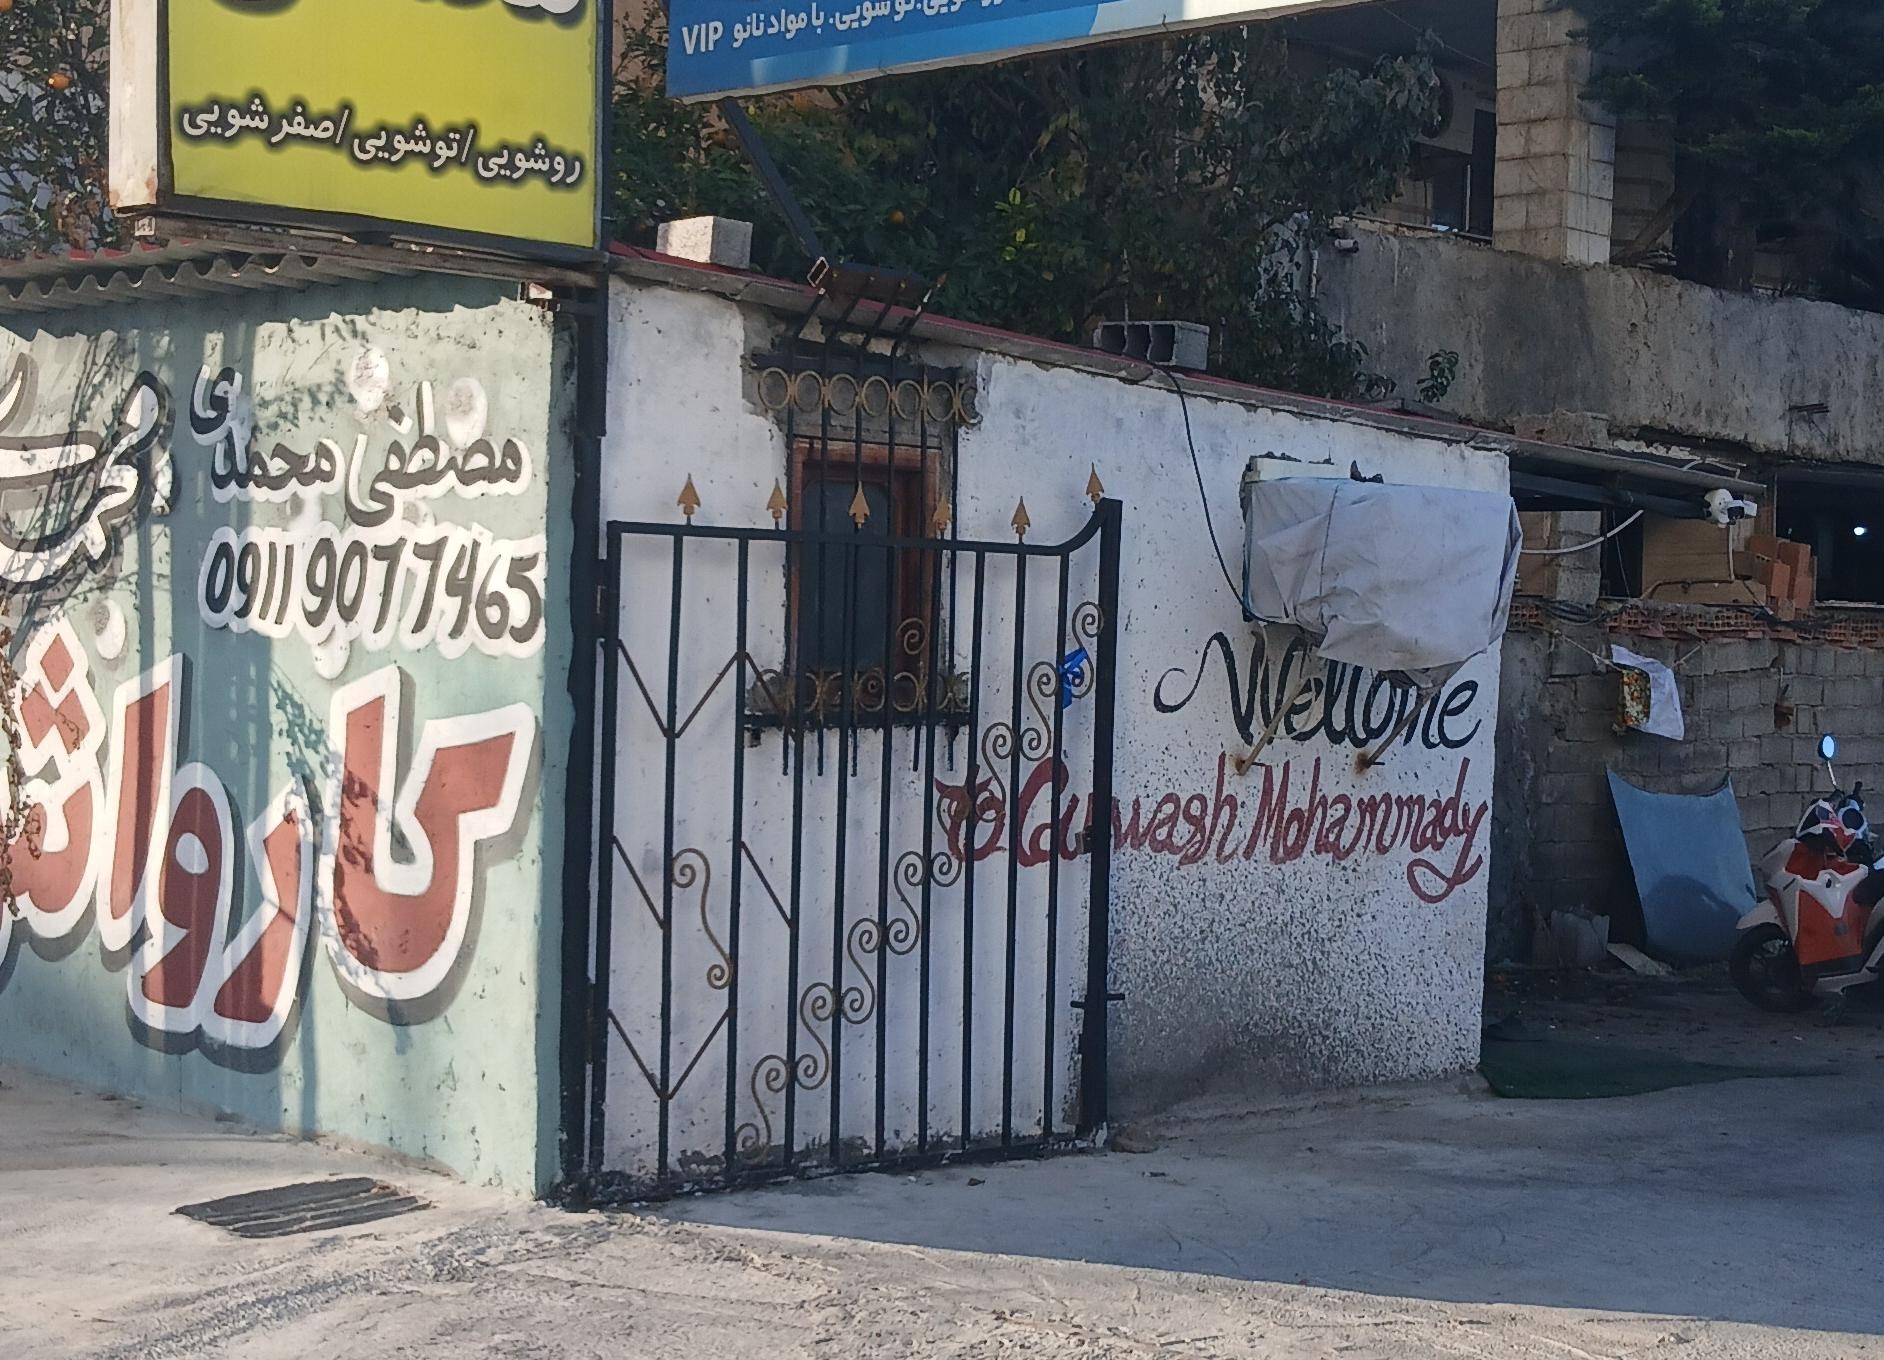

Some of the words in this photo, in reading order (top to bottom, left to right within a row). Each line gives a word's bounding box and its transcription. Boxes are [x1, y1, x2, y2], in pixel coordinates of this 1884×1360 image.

[681, 20, 724, 55] VIP
[189, 364, 338, 491] محمدی
[344, 378, 525, 528] مصطفی
[1242, 756, 1489, 904] Mohammady
